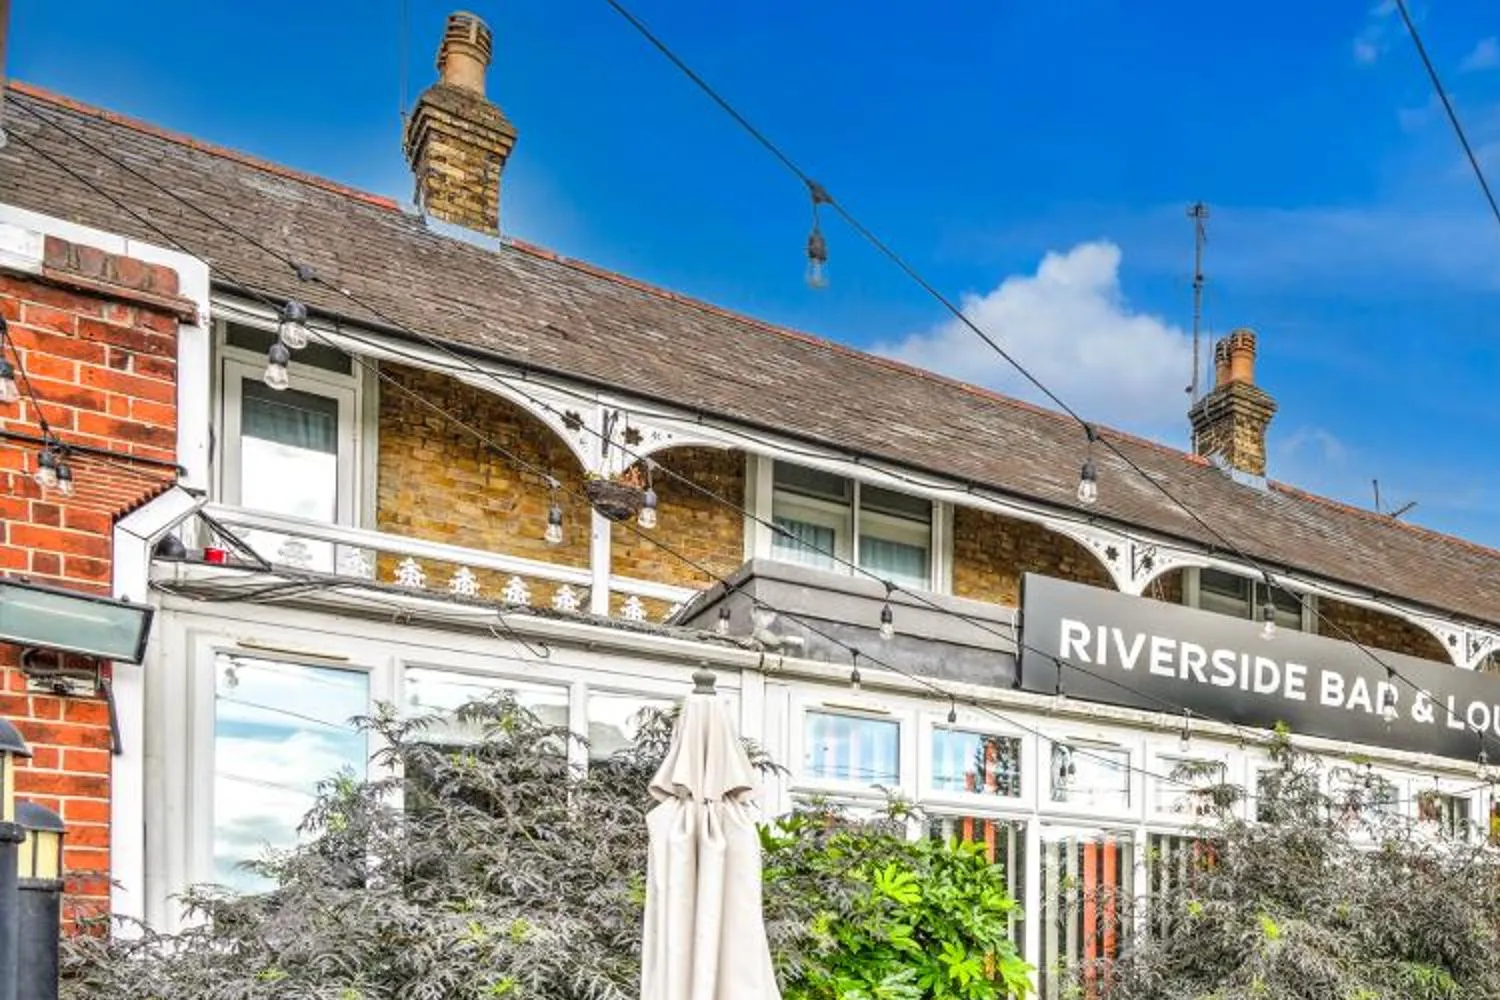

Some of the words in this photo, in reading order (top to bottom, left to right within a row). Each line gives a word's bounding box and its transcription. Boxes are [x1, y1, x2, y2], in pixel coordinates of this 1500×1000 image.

[1059, 618, 1308, 701] RIVERSIDE
[1320, 669, 1399, 719] BAR
[1411, 689, 1435, 723] &
